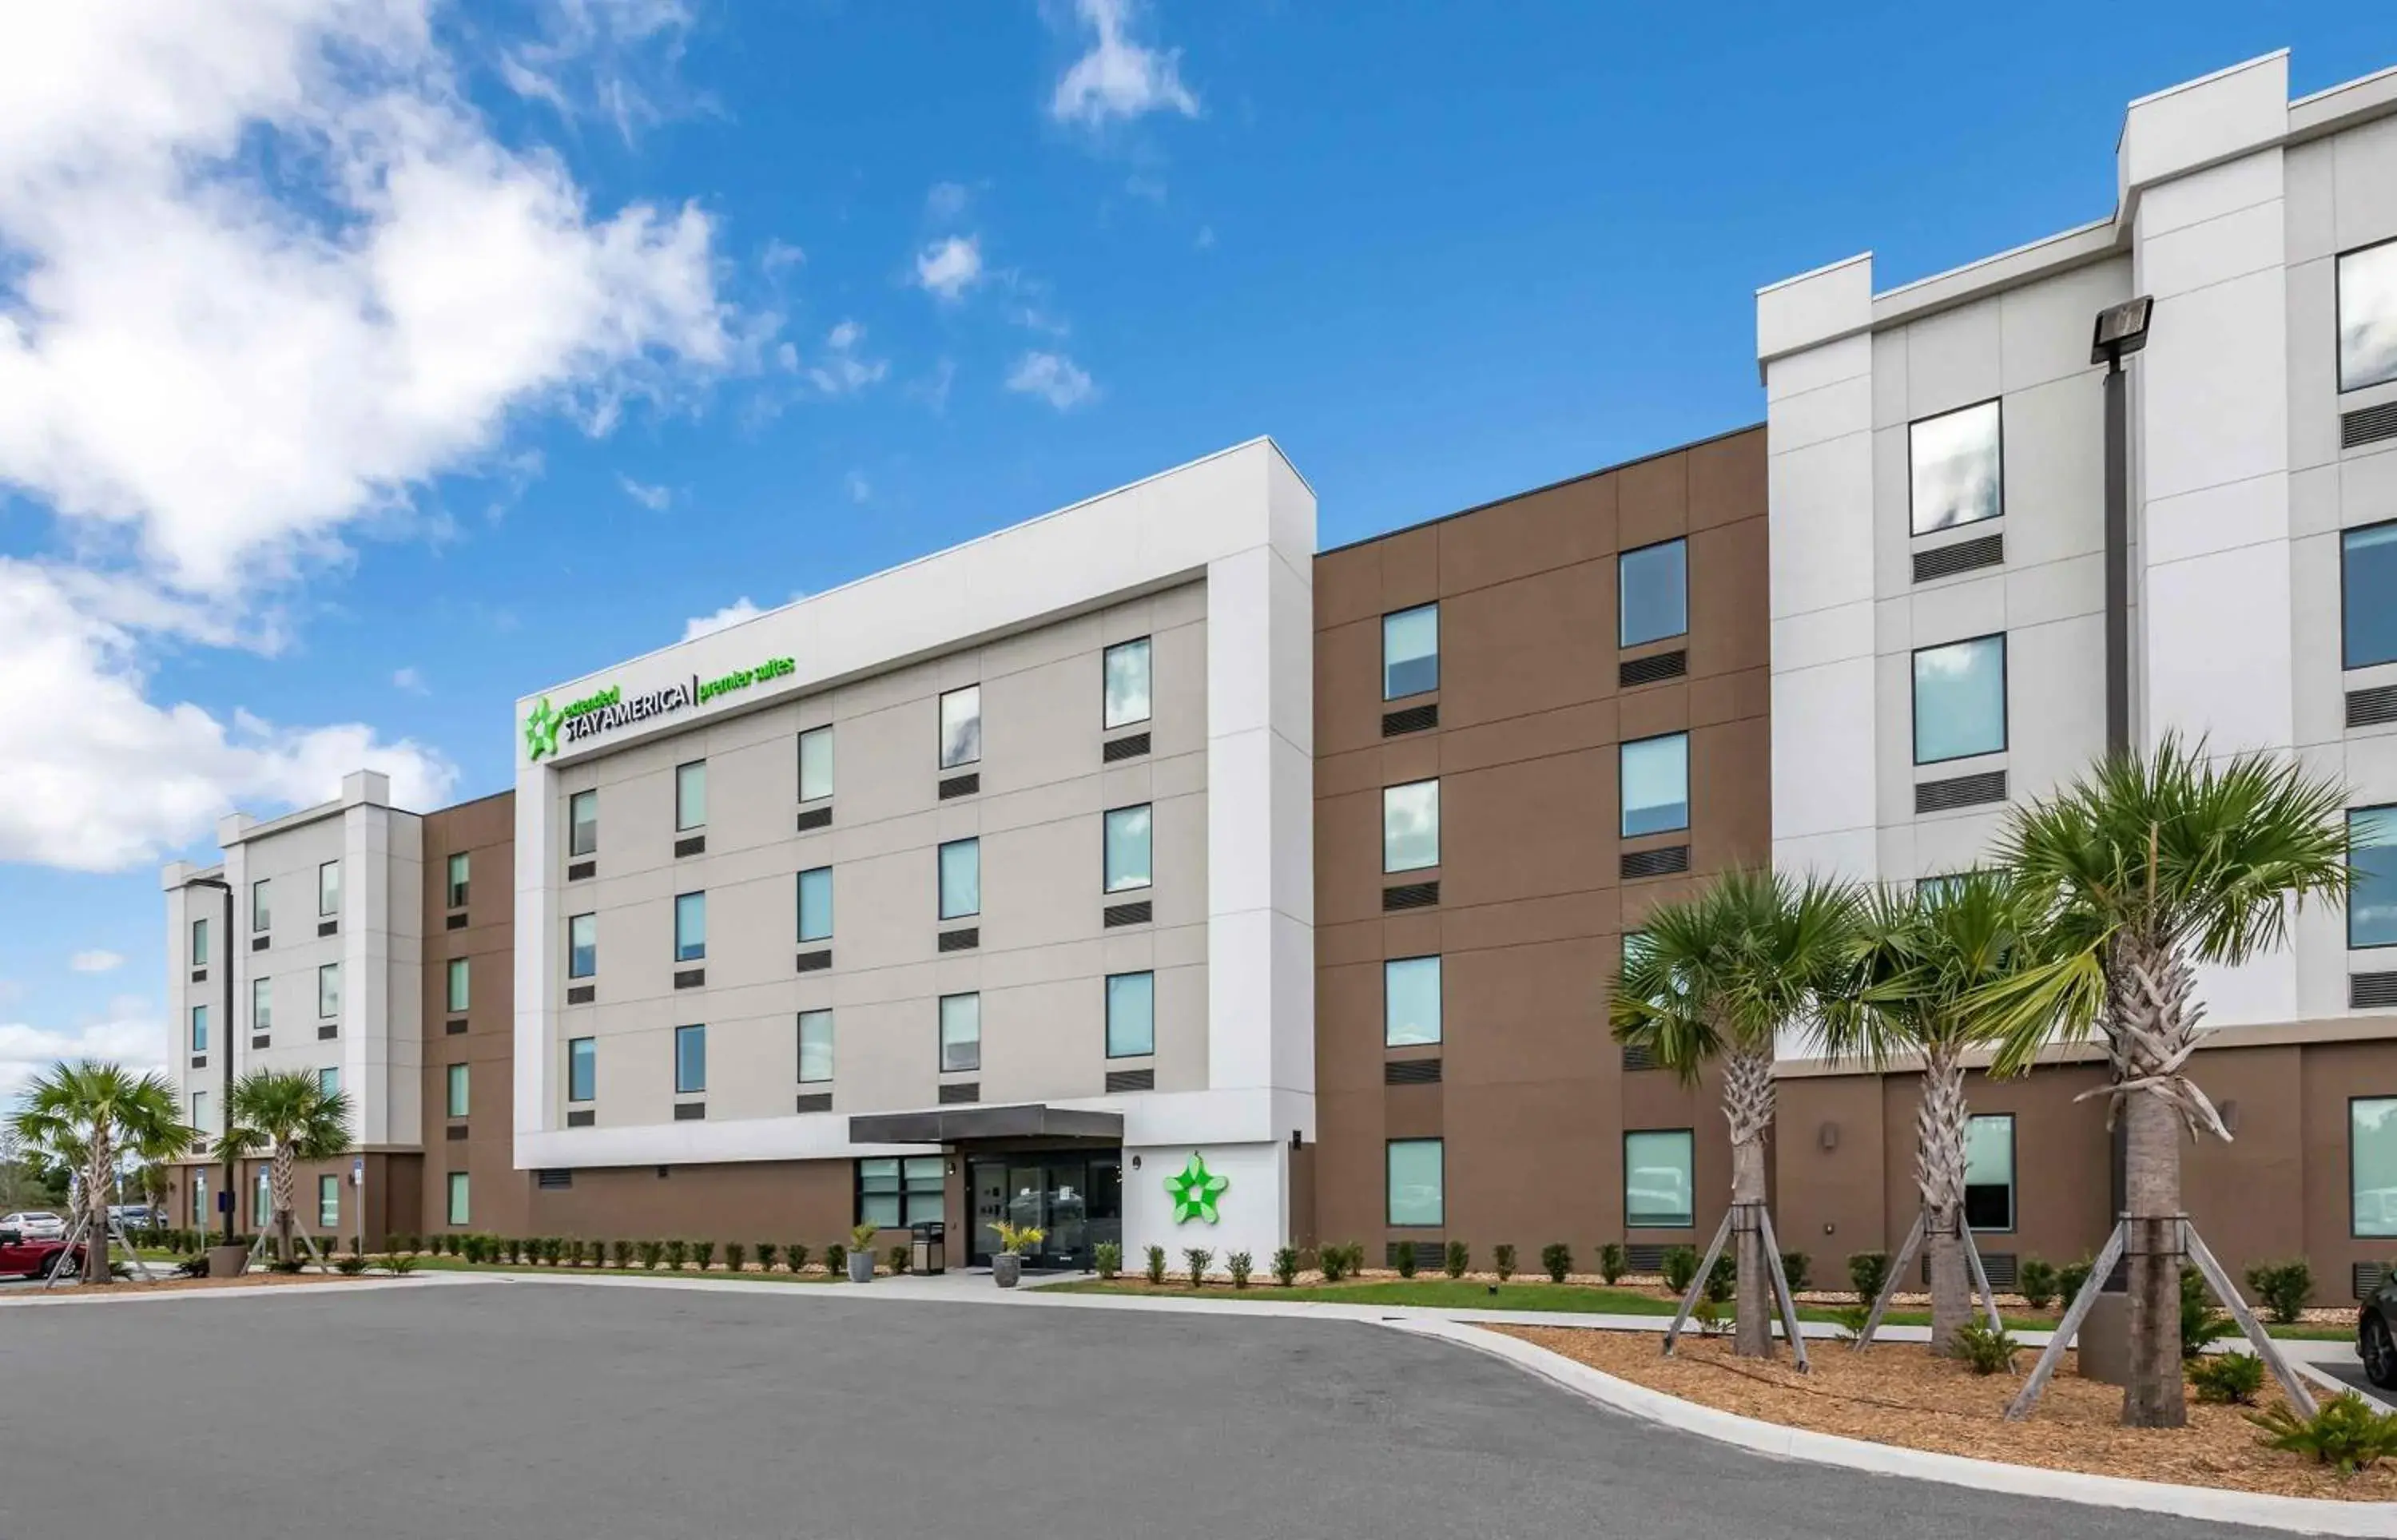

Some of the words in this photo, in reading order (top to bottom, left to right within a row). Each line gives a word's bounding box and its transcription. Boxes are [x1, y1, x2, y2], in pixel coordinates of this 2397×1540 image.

[700, 670, 753, 704] premier
[754, 657, 796, 683] suites
[564, 685, 620, 717] extended
